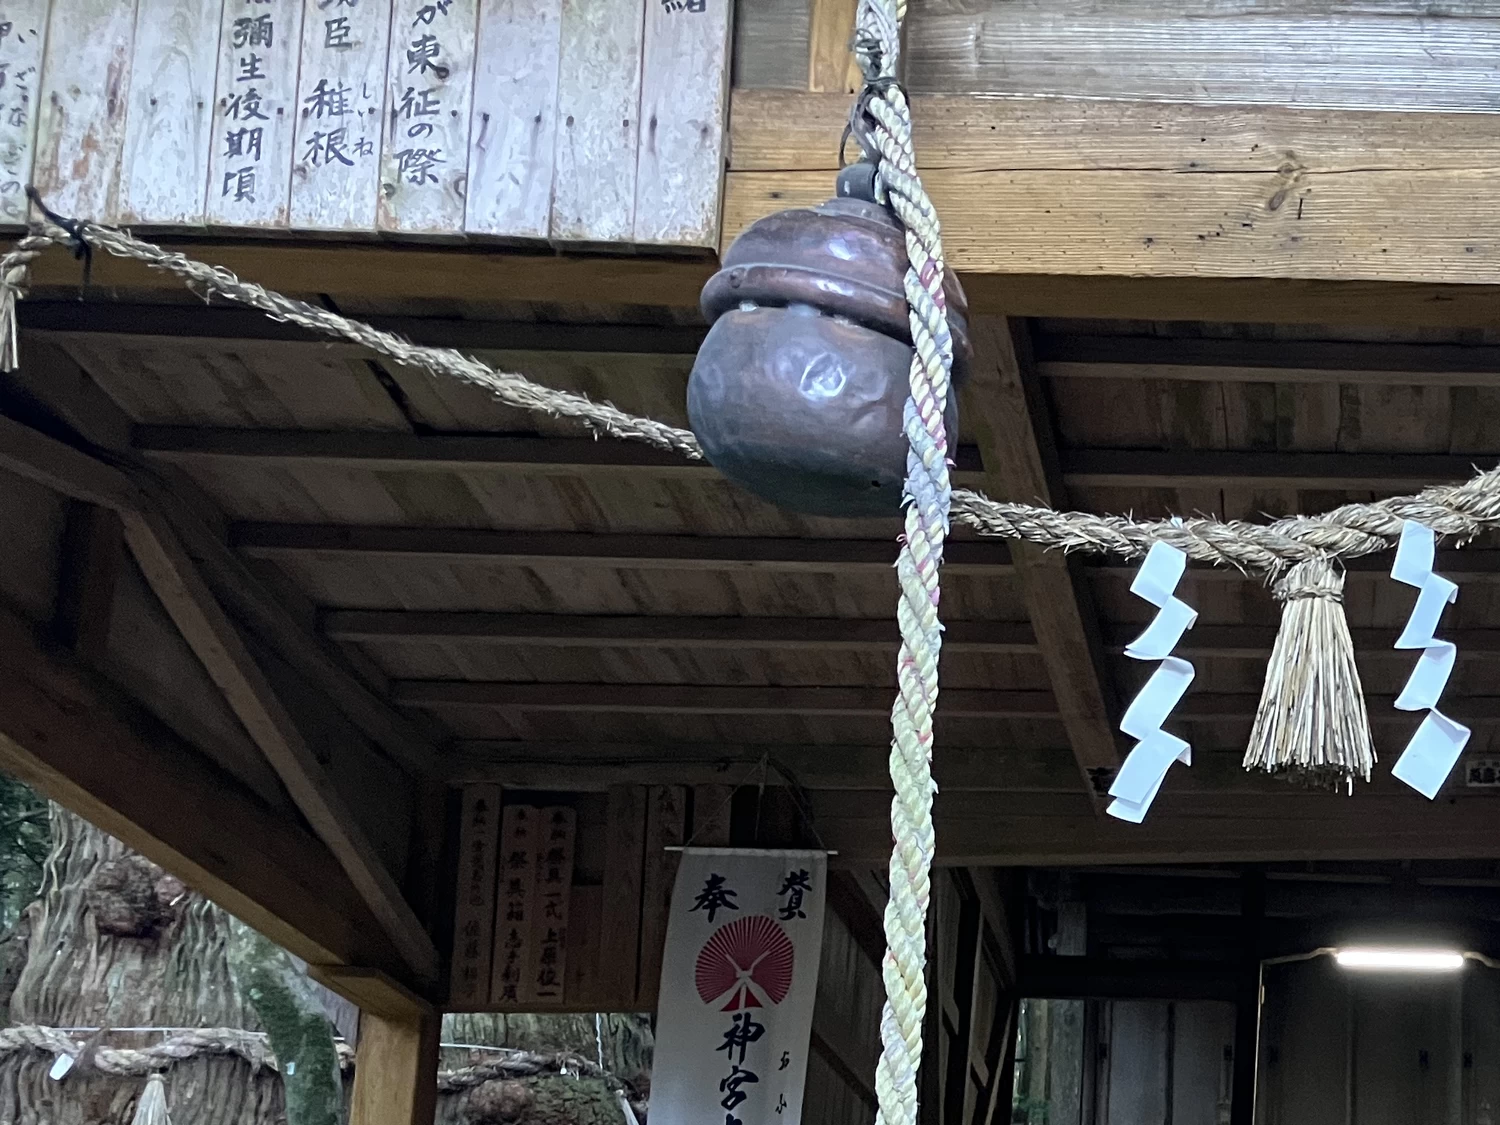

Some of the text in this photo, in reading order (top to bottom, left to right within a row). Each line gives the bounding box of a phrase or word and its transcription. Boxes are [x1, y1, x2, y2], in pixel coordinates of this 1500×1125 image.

[221, 0, 274, 203] 彌生後期頃
